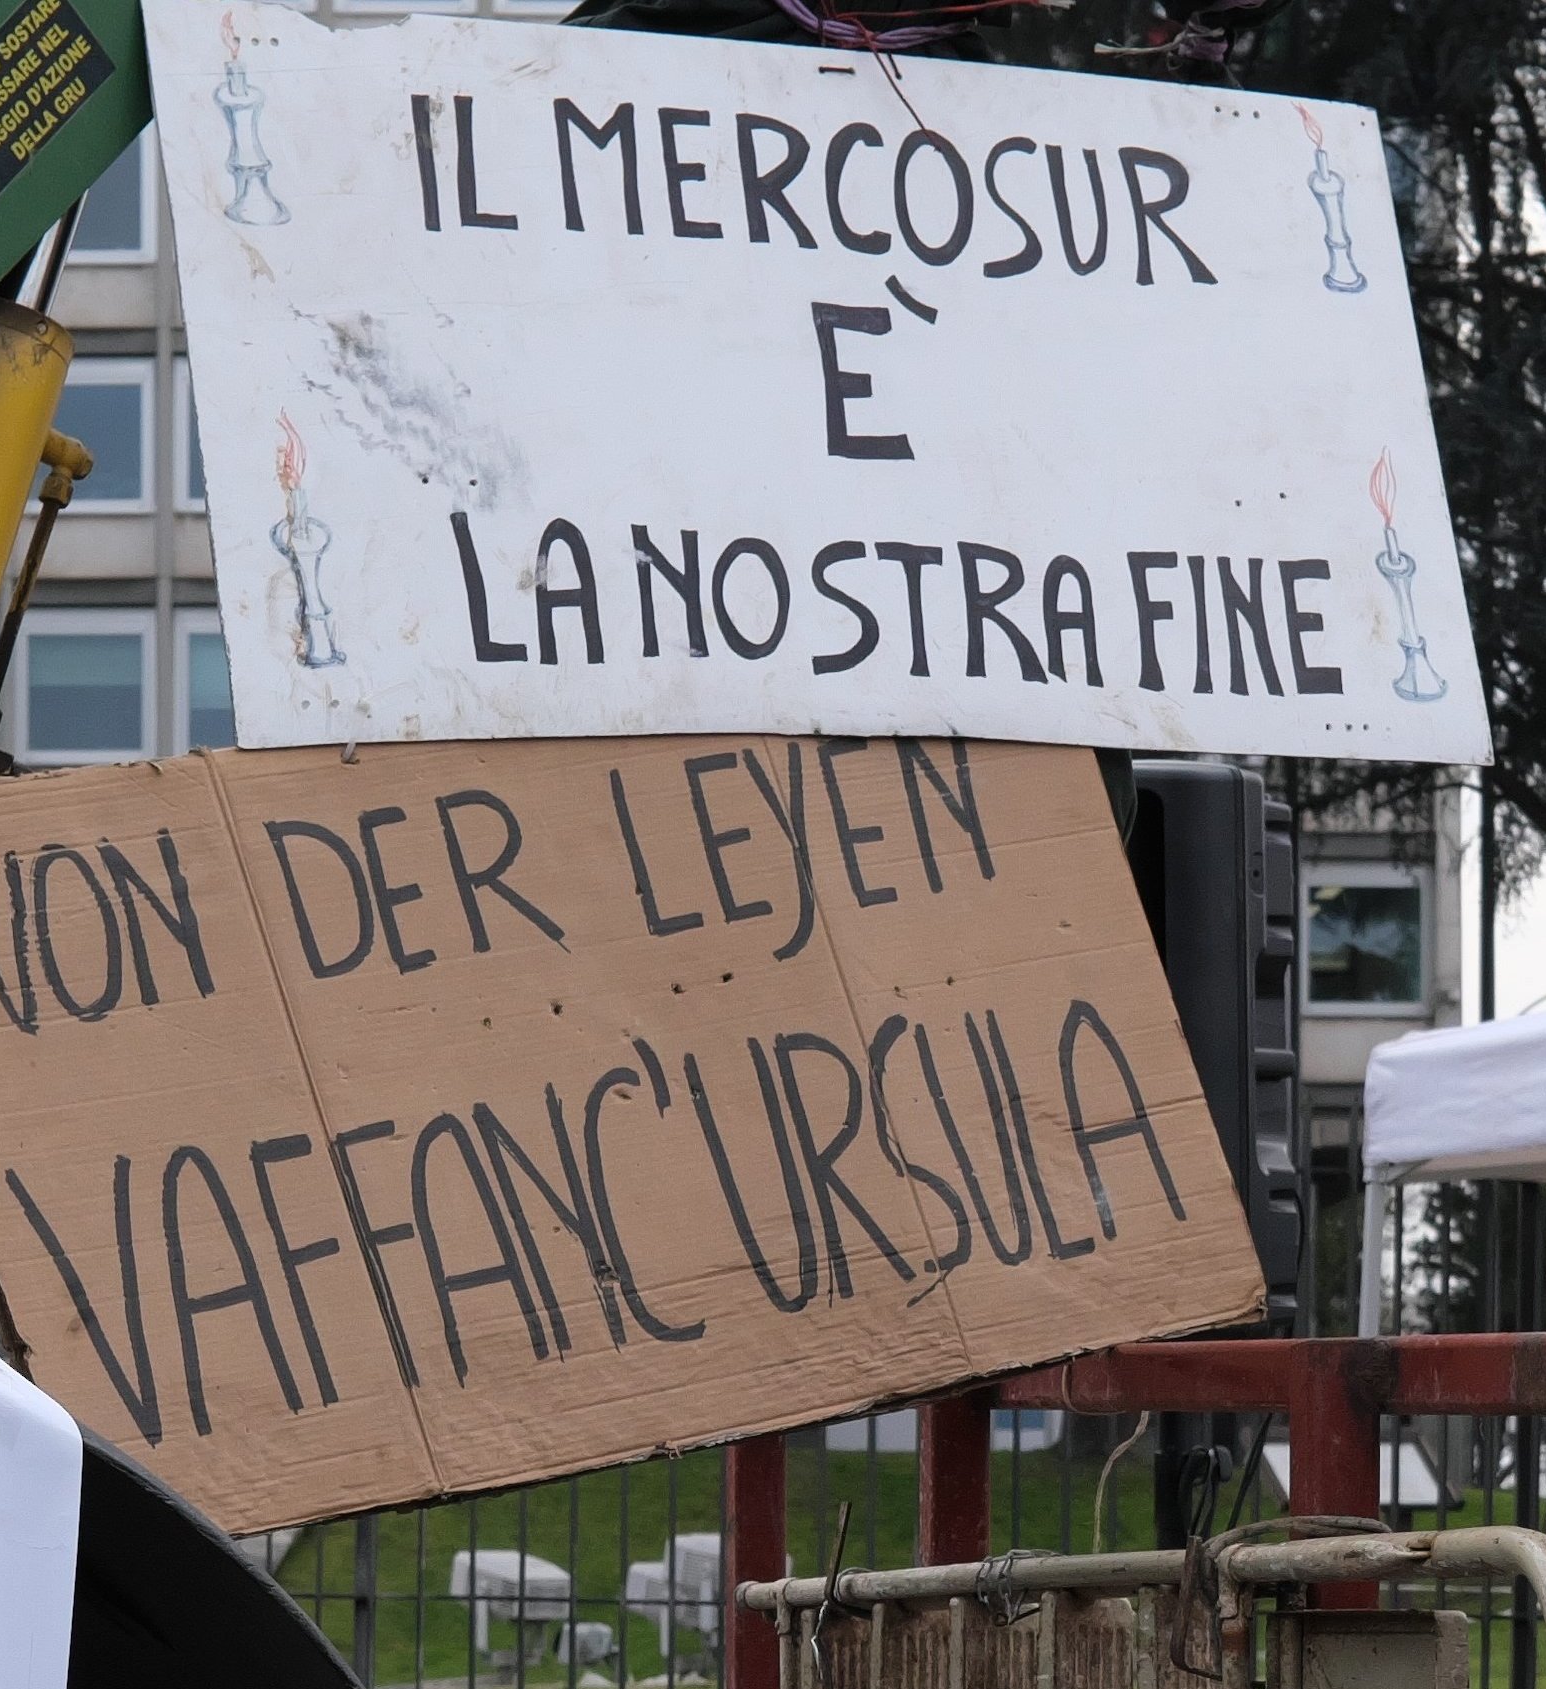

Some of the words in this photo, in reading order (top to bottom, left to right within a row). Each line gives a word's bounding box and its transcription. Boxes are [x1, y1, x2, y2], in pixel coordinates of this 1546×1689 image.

[10, 110, 58, 160] DELLA
[54, 77, 87, 115] GRU
[26, 35, 92, 106] D'AZIONE
[37, 23, 69, 59] NEL
[413, 95, 518, 233] IL
[557, 97, 1216, 287] MERCOSUR
[451, 513, 603, 664] LA
[632, 525, 1103, 687] NOSTRA
[1128, 553, 1342, 696] FINE
[265, 791, 569, 979] DER
[7, 1000, 1190, 1446] VAFFANC'URSULA
